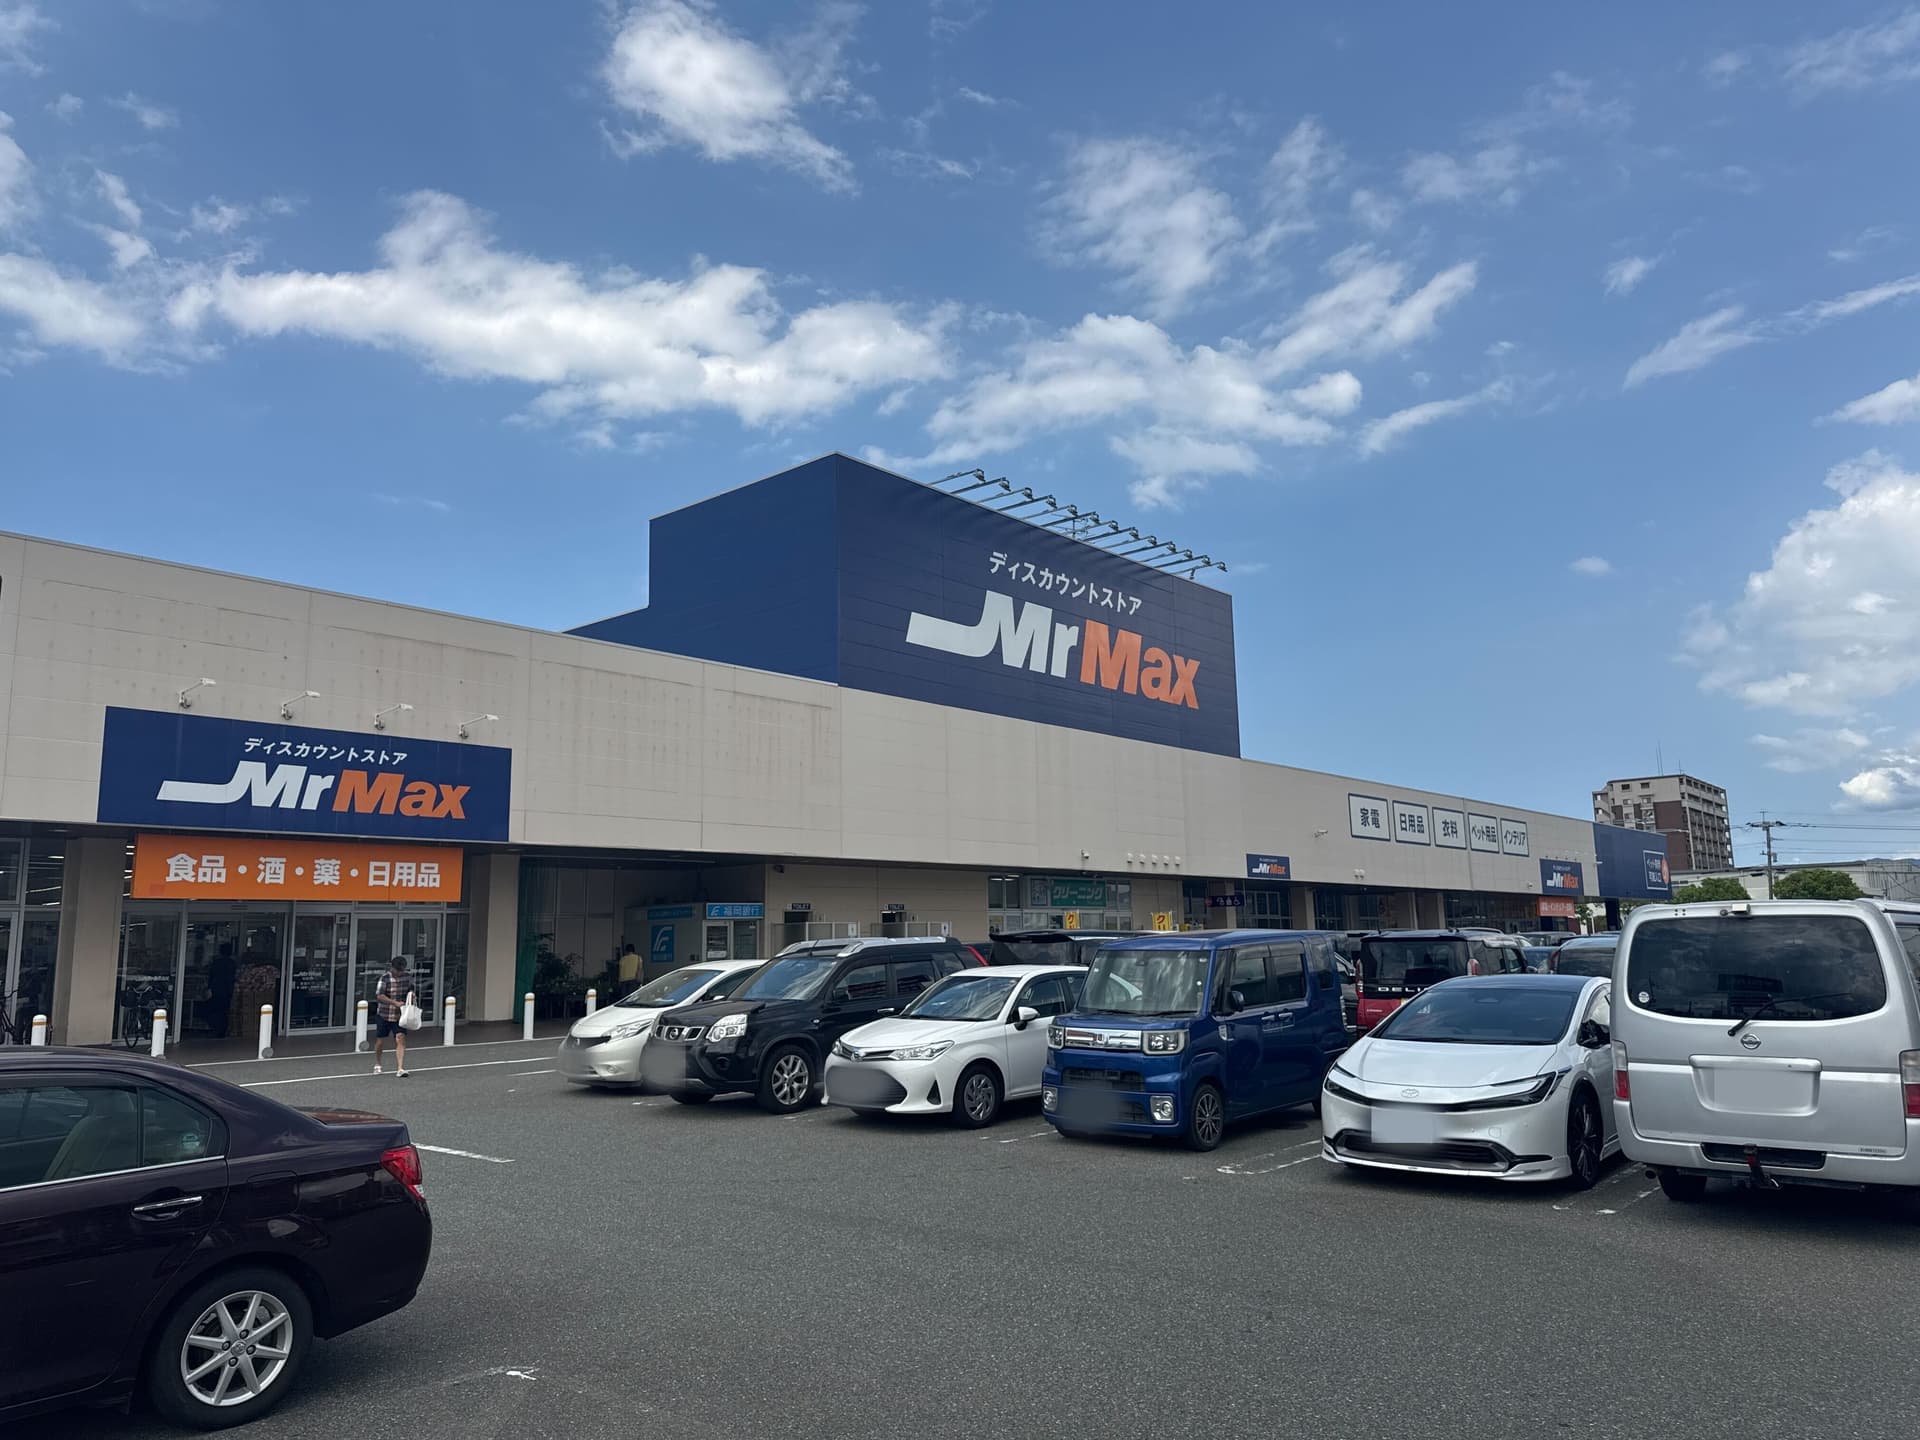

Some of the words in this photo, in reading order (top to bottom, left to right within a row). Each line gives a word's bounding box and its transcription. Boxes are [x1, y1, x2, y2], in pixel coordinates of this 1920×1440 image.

[988, 551, 1143, 616] ディスカウントストア
[905, 590, 1201, 710] MrMax
[244, 736, 408, 766] ディスカウントストア
[156, 760, 471, 820] MrMax
[1359, 808, 1381, 829] 家電
[1399, 813, 1425, 834] 日用品
[1441, 819, 1458, 839] 衣料
[1471, 825, 1497, 843] ペット用品
[1503, 829, 1526, 847] インテリア
[165, 853, 441, 889] 食品・酒・薬・日用品
[1052, 885, 1104, 900] クリーニング
